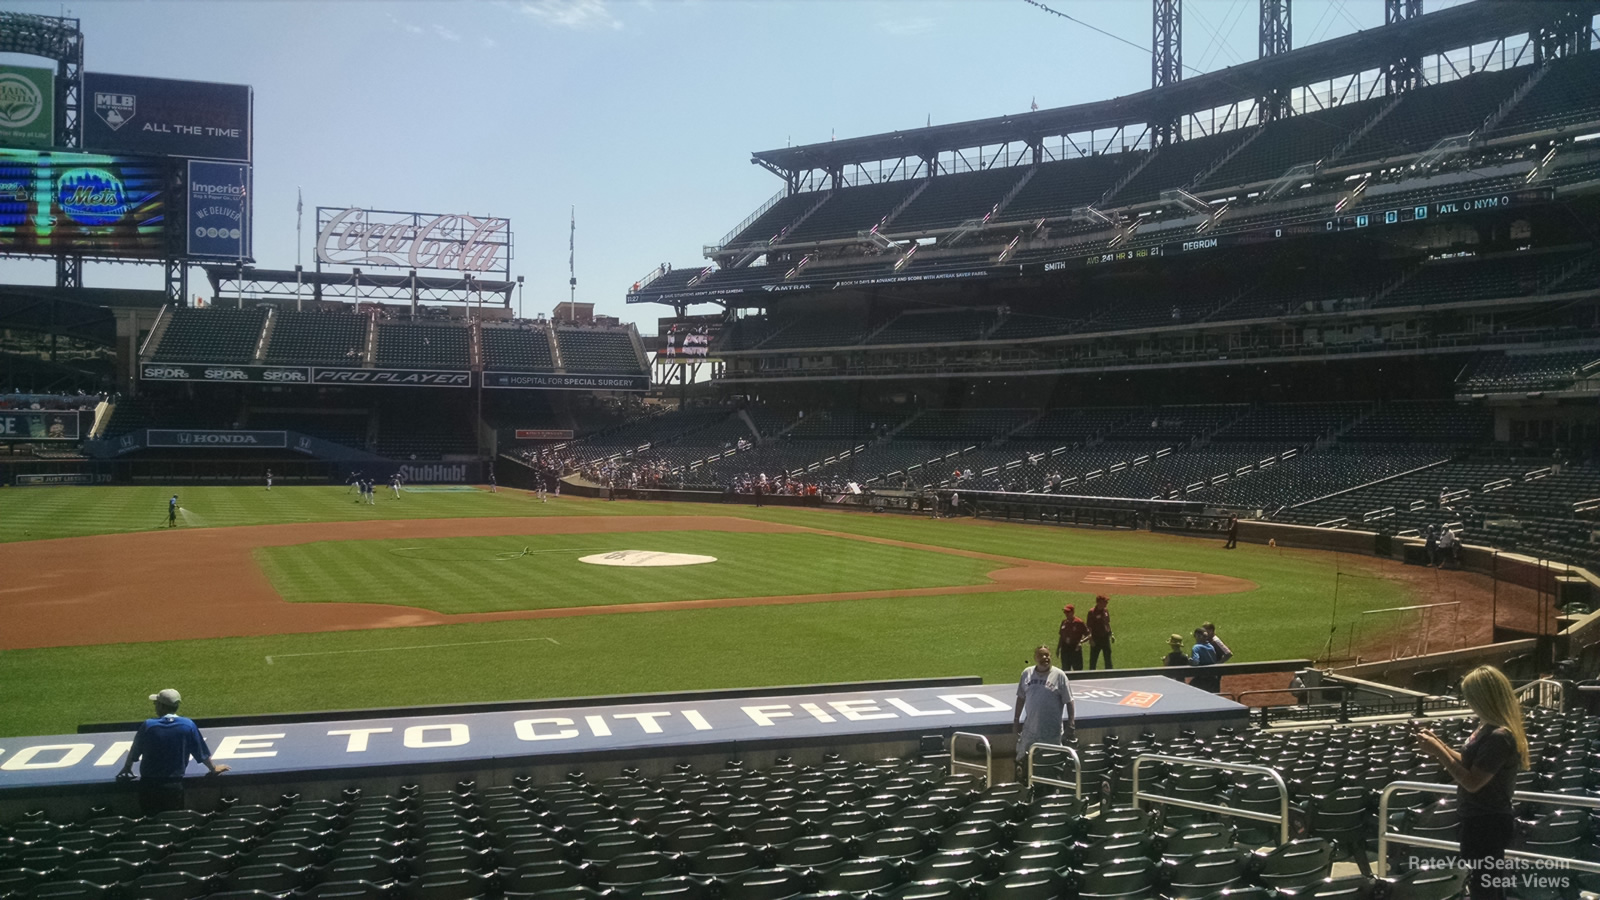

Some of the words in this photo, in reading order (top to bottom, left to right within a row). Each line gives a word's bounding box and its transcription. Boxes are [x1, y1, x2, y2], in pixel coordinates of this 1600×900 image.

[97, 94, 133, 106] MLB
[143, 123, 171, 133] ALL
[173, 124, 202, 135] THE
[205, 127, 240, 138] TIME
[192, 182, 242, 195] Imperia
[65, 186, 118, 207] Mets
[1440, 203, 1459, 214] ATL
[1474, 198, 1498, 208] NYM
[196, 207, 209, 219] WE
[209, 206, 241, 222] DELIVER
[1388, 212, 1395, 222] 0
[1417, 207, 1425, 218] 0
[318, 207, 509, 272] Coca-Cola
[1183, 238, 1217, 252] DEGROM
[1275, 229, 1282, 238] 0
[1326, 221, 1333, 230] 0
[1044, 261, 1066, 272] SMITH
[1086, 257, 1099, 265] AVG
[1100, 254, 1114, 263] .241
[1115, 252, 1126, 260] HR
[1128, 251, 1133, 259] 3
[1136, 249, 1148, 257] RBI
[1150, 248, 1159, 256] 21
[774, 284, 811, 292] AMTRAK
[315, 371, 371, 382] PRO
[371, 372, 468, 384] PLAYER
[510, 377, 547, 385] HOSPITAL
[547, 377, 563, 385] FOR
[563, 378, 597, 386] SPECIAL
[598, 379, 634, 387] SURGERY
[193, 434, 258, 444] HONDA
[96, 474, 112, 482] 370
[399, 464, 466, 481] StubHub!
[327, 723, 471, 753] TO
[513, 709, 713, 742] CITI
[740, 693, 1013, 727] FIELD
